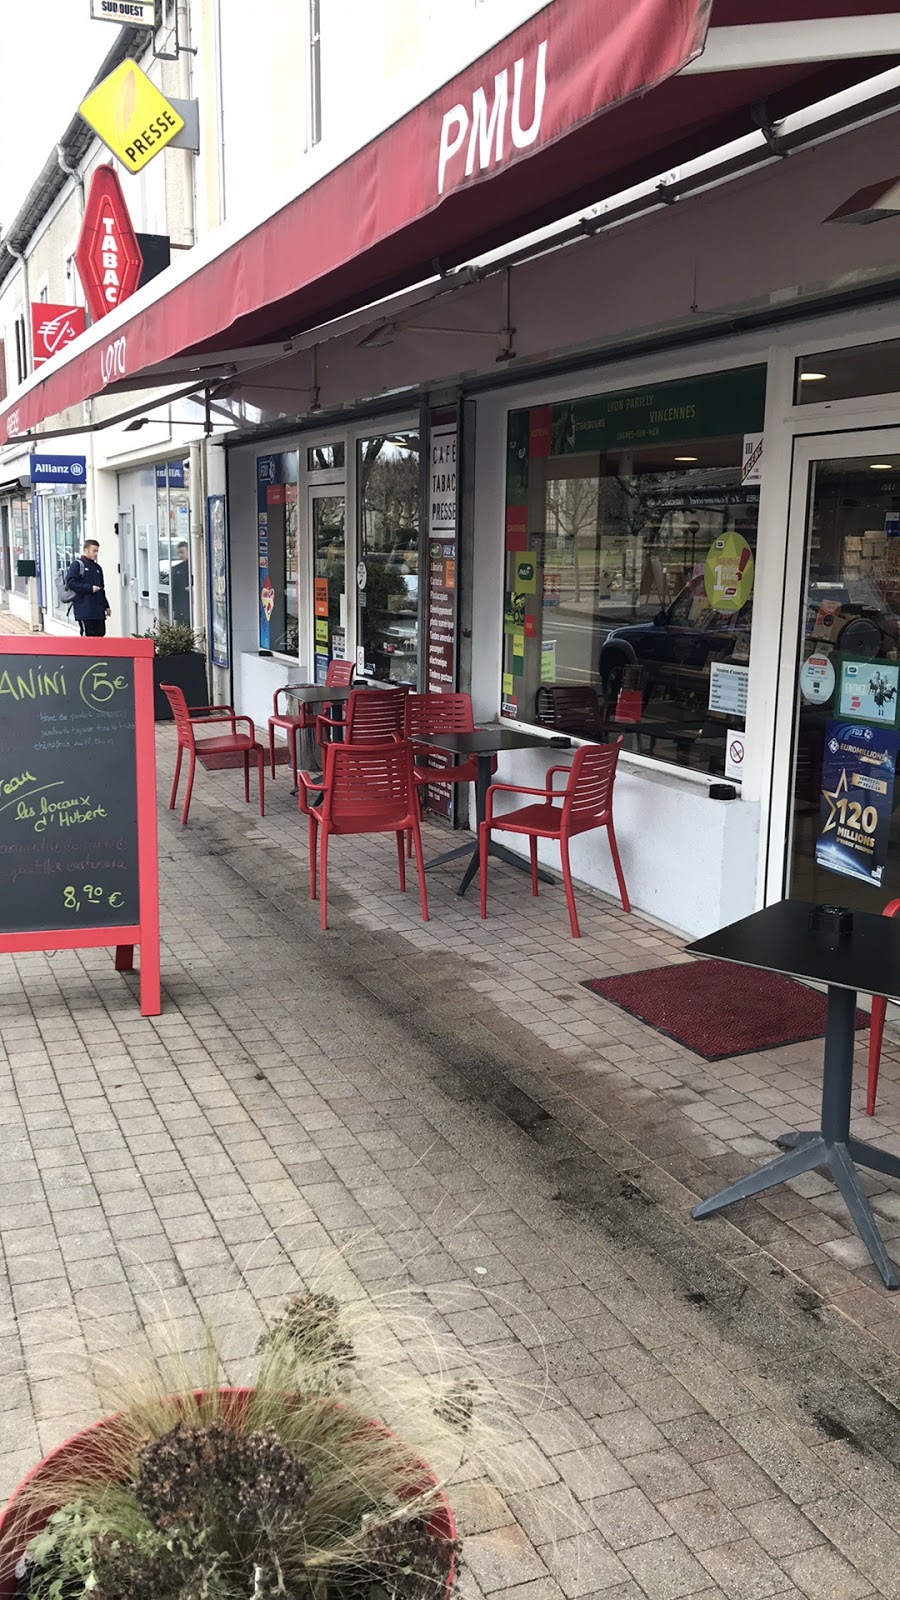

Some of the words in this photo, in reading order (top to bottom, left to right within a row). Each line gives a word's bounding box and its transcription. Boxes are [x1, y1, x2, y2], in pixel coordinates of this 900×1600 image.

[101, 1, 118, 12] SUD
[119, 4, 144, 17] OUEST
[438, 40, 547, 195] PMU
[124, 110, 176, 163] PRESSE
[101, 217, 120, 303] TABAC
[100, 336, 126, 384] LOTO
[607, 400, 624, 413] LYON
[626, 395, 654, 411] PARILLY
[649, 404, 697, 424] VINCENNES
[574, 419, 606, 431] STRASBOURG
[616, 427, 660, 441] CAGNES-SUR-MER
[432, 440, 456, 465] CAFÉ
[34, 463, 69, 474] Allianz
[432, 473, 456, 493] TABAC
[432, 502, 456, 521] PRESSE
[851, 728, 863, 737] FDJ
[840, 742, 886, 762] EUROMILLIONS
[836, 797, 879, 834] 120
[836, 826, 876, 848] MILLIONS
[108, 891, 125, 908] €
